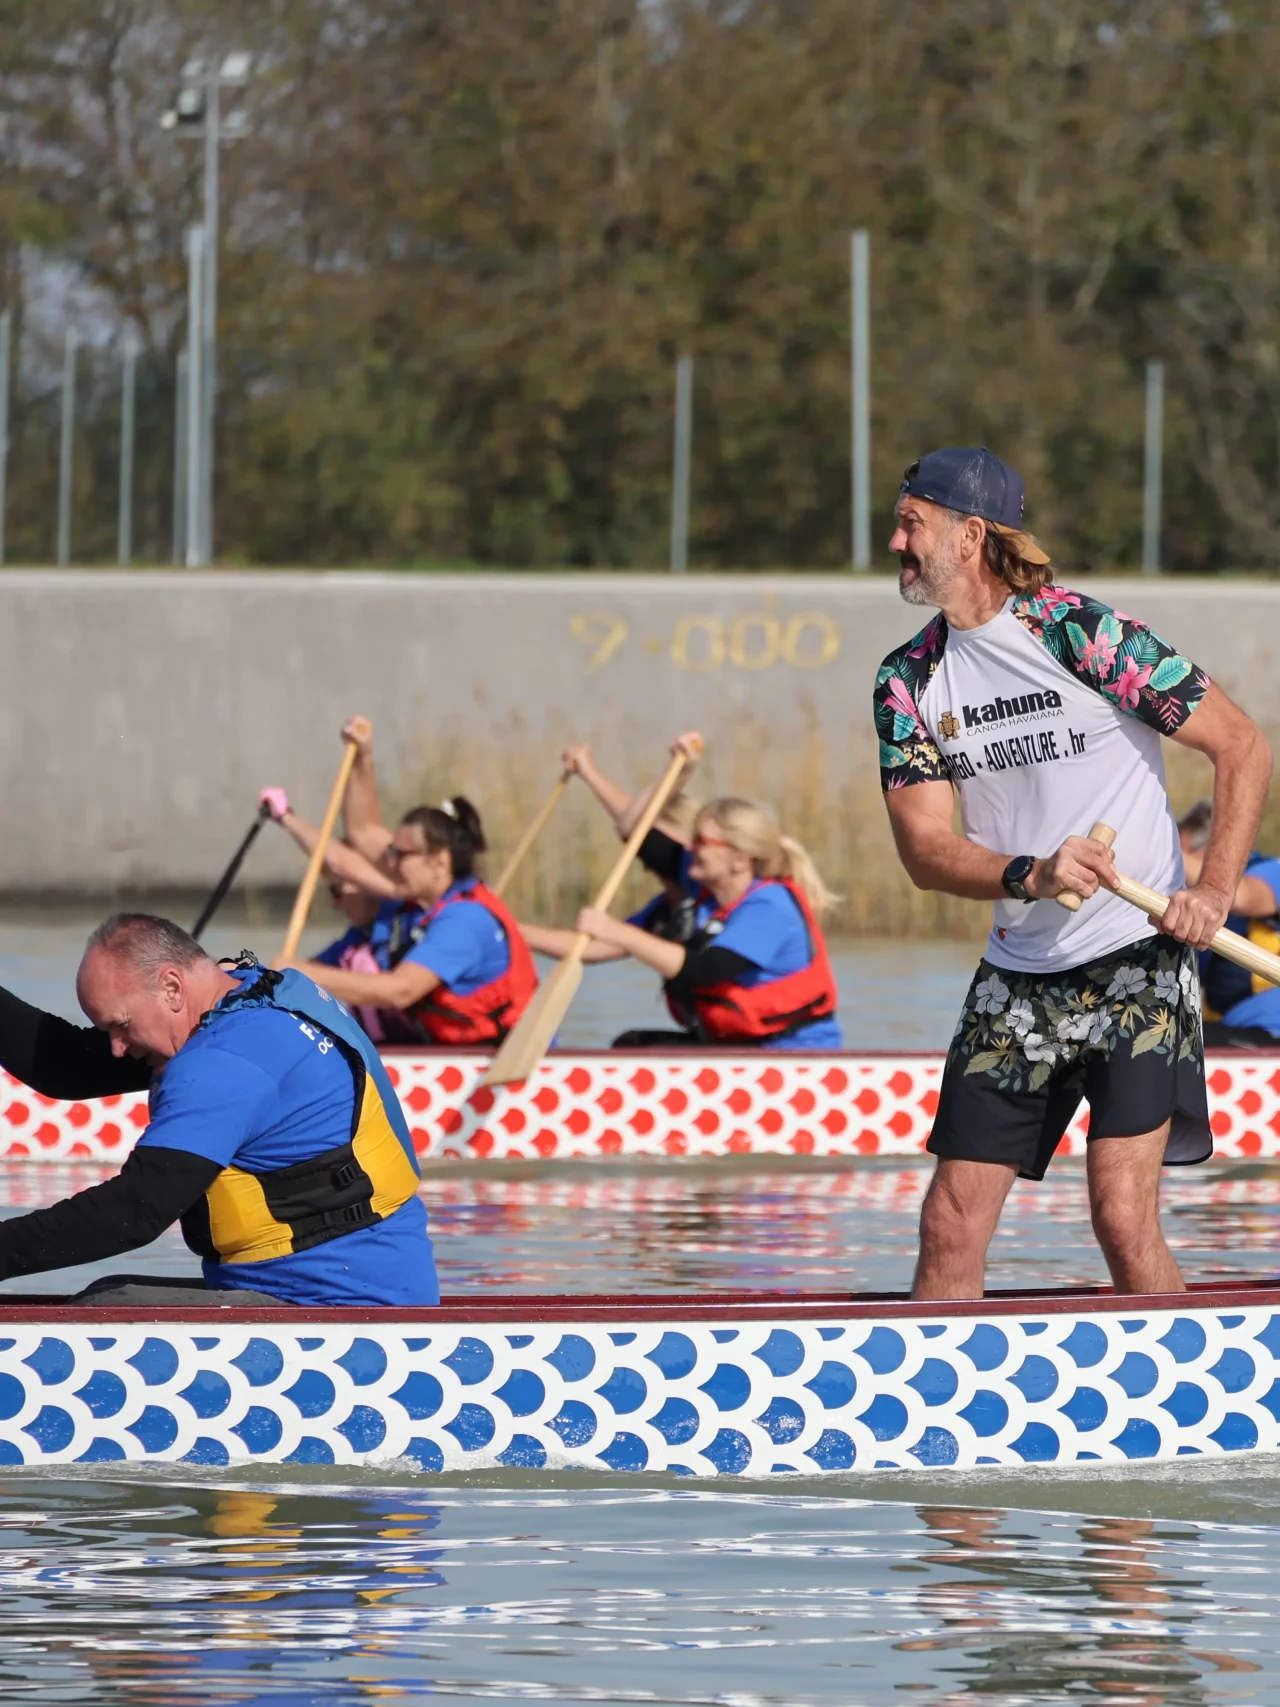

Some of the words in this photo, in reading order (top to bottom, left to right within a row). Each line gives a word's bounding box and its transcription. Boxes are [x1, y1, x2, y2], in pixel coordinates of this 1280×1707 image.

[962, 690, 1062, 728] kahuna
[966, 720, 1007, 737] CANOA
[1009, 708, 1065, 726] HAVAIANA
[944, 751, 977, 780] RGO
[983, 730, 1060, 772] ADVENTURE
